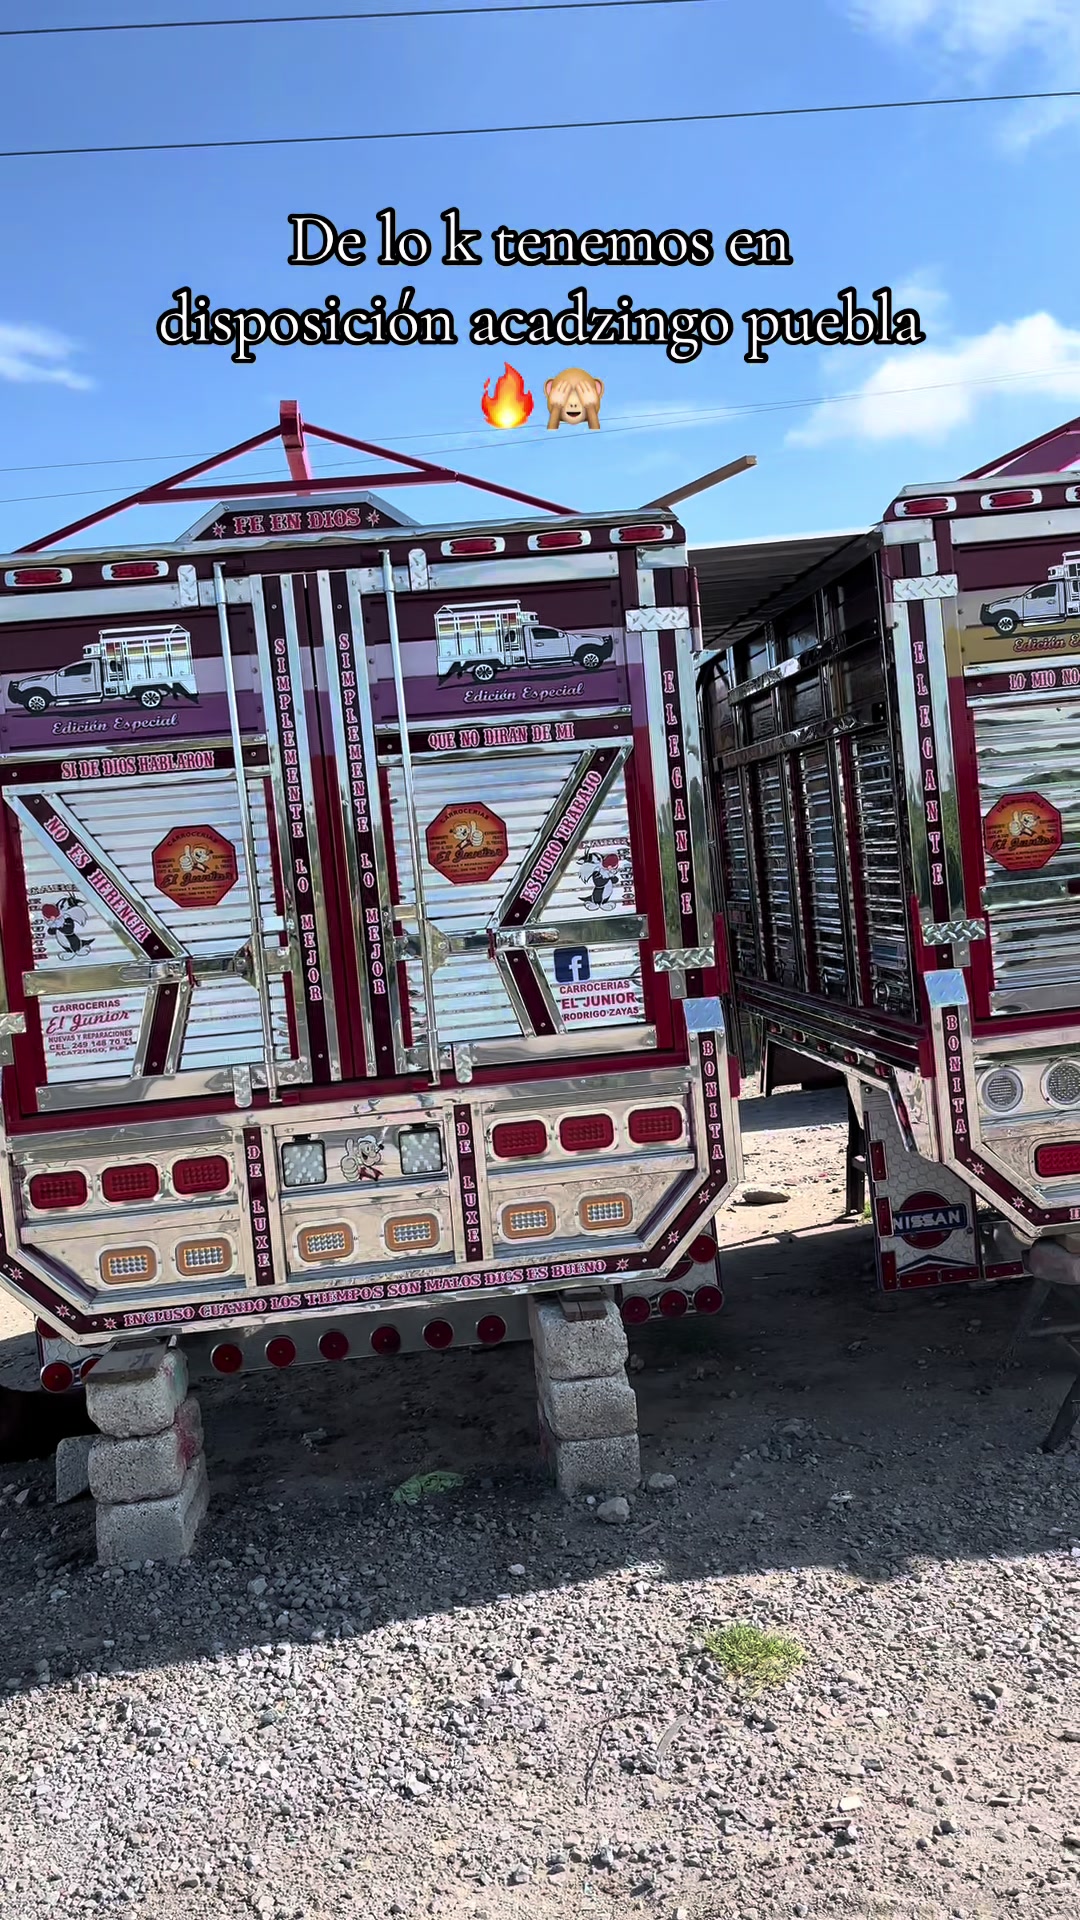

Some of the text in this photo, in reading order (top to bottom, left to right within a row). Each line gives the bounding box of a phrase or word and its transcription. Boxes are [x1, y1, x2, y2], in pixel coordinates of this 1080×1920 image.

[234, 508, 361, 534] FE EN DIOS
[1013, 636, 1066, 652] Edición
[463, 682, 585, 704] Edición Especial
[1009, 668, 1080, 690] LO MIO NO
[51, 713, 178, 735] Edición Especial
[428, 722, 575, 750] QUE NO DIRAN DE MI
[61, 751, 215, 779] SI DE DIOS HABLARON
[913, 641, 943, 885] ELEGANTE
[663, 670, 692, 915] ELEGANTE
[274, 638, 322, 1001] SIMPLEMENTE LO MEJOR
[339, 633, 385, 994] SIMPLEMENTE LO MEJOR
[520, 770, 602, 904] ES PURO TRABAJO
[44, 815, 151, 943] NO ES HERENCIA
[560, 980, 630, 994] CARROCERIAS
[562, 992, 636, 1009] EL JUNIOR
[52, 999, 120, 1013] CARROCERIAS
[563, 1006, 639, 1021] RODRIGO ZAYAS
[46, 1010, 129, 1034] El Junior
[48, 1035, 75, 1043] NUEVAS
[83, 1029, 133, 1040] REPARACIONES
[947, 1014, 967, 1134] BONITA
[702, 1041, 724, 1160] BONITA
[457, 1122, 480, 1242] DE LUXE
[247, 1146, 270, 1268] DE LUXE
[893, 1210, 960, 1230] NISSAN
[123, 1307, 195, 1327] INCLUSO
[199, 1298, 267, 1317] CUANDO
[270, 1295, 301, 1310] LOS
[304, 1285, 384, 1306] TIEMPOS
[387, 1282, 422, 1296] SON
[425, 1275, 481, 1291] MALOS
[528, 1267, 549, 1280] ES
[551, 1260, 607, 1277] BUENO
